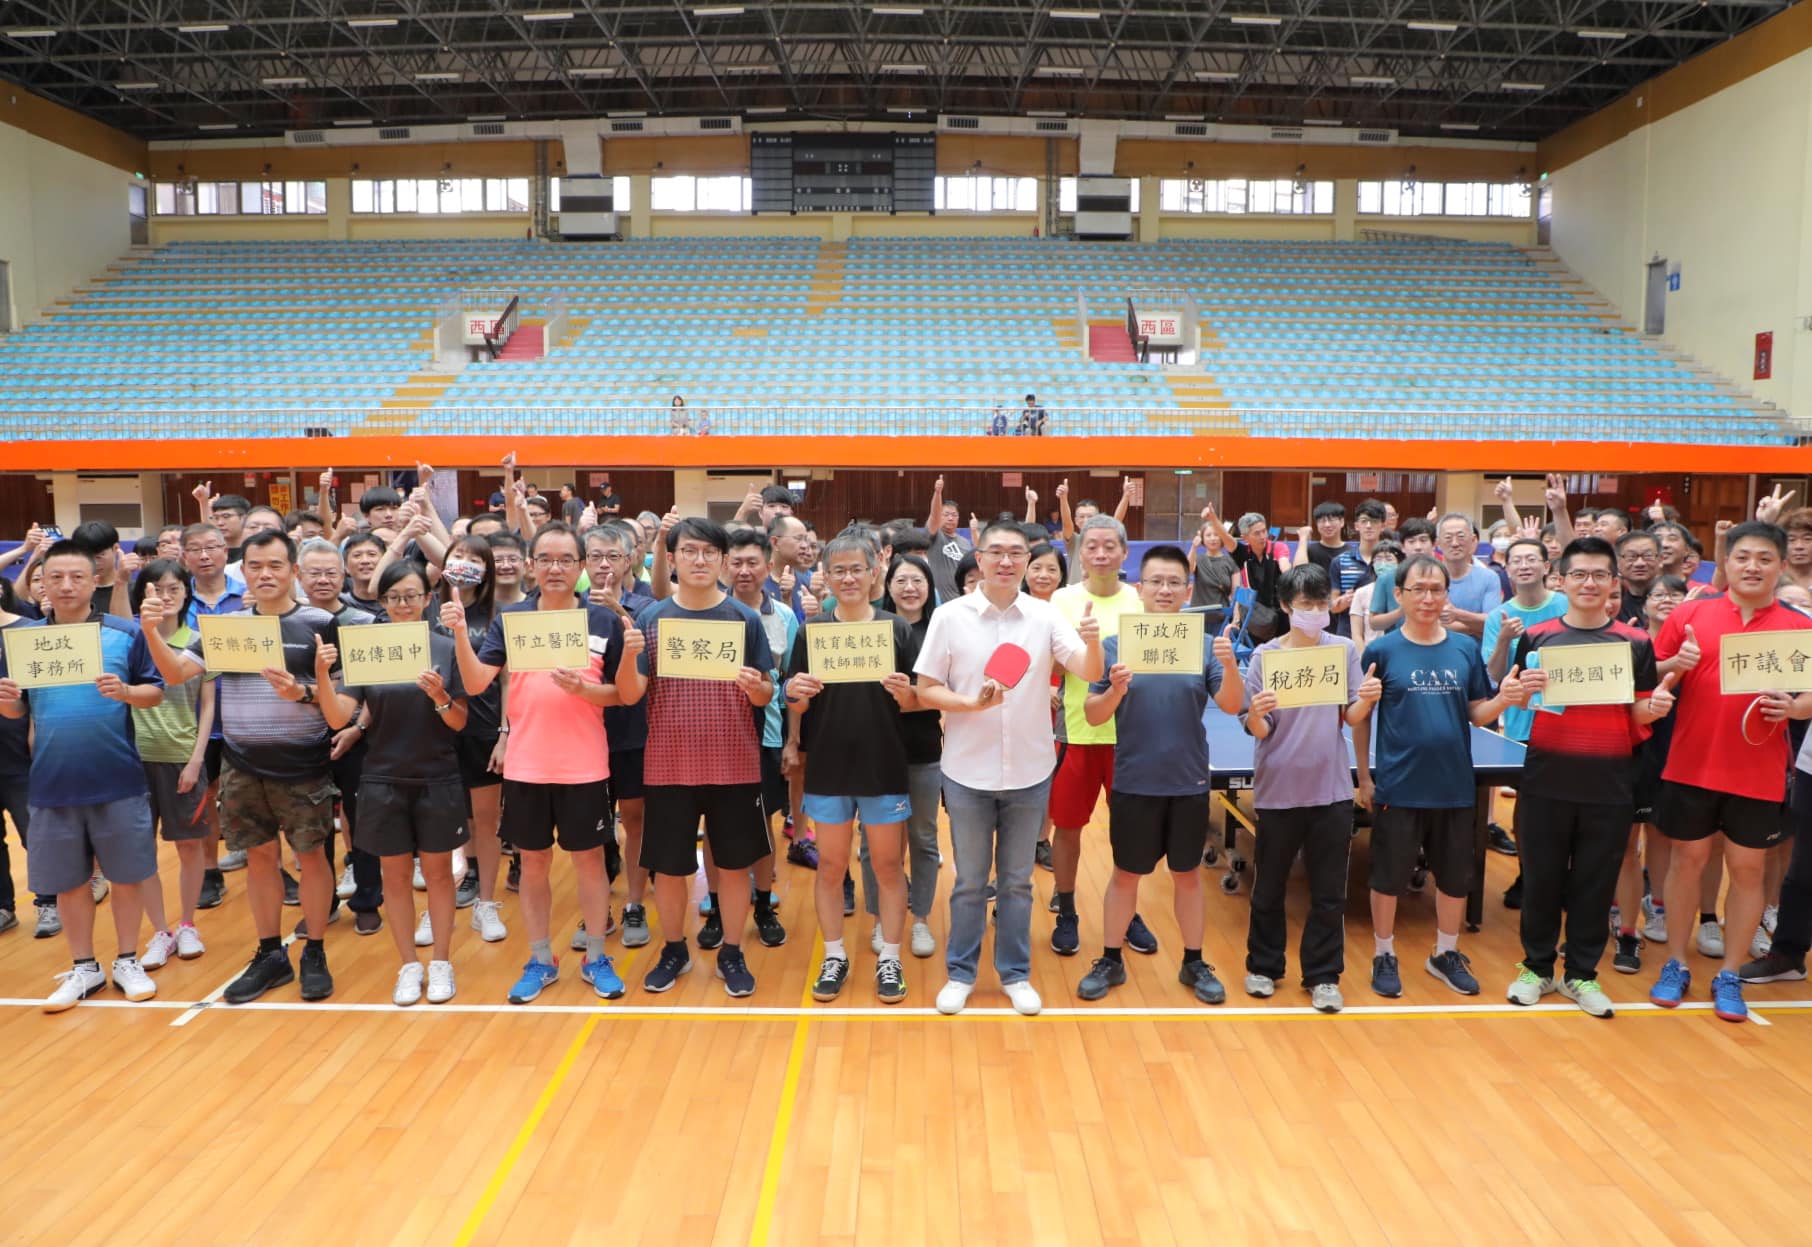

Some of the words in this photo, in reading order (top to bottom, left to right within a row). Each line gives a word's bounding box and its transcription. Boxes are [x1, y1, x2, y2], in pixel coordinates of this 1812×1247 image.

[1141, 319, 1175, 335] 西區
[1134, 622, 1189, 640] 市政府
[34, 636, 73, 651] 地政
[209, 637, 275, 653] 安樂高中
[512, 632, 583, 649] 市立醫院
[666, 636, 737, 662] 警察局
[815, 634, 888, 650] 教育處校長
[350, 643, 422, 662] 銘傳國中
[1143, 647, 1179, 664] 聯隊
[28, 658, 84, 678] 事務所
[823, 655, 882, 670] 教師聯隊
[1728, 649, 1812, 674] 市議會
[1270, 664, 1339, 691] 稅務局
[1411, 669, 1458, 686] CAN
[1549, 664, 1622, 683] 明德國中
